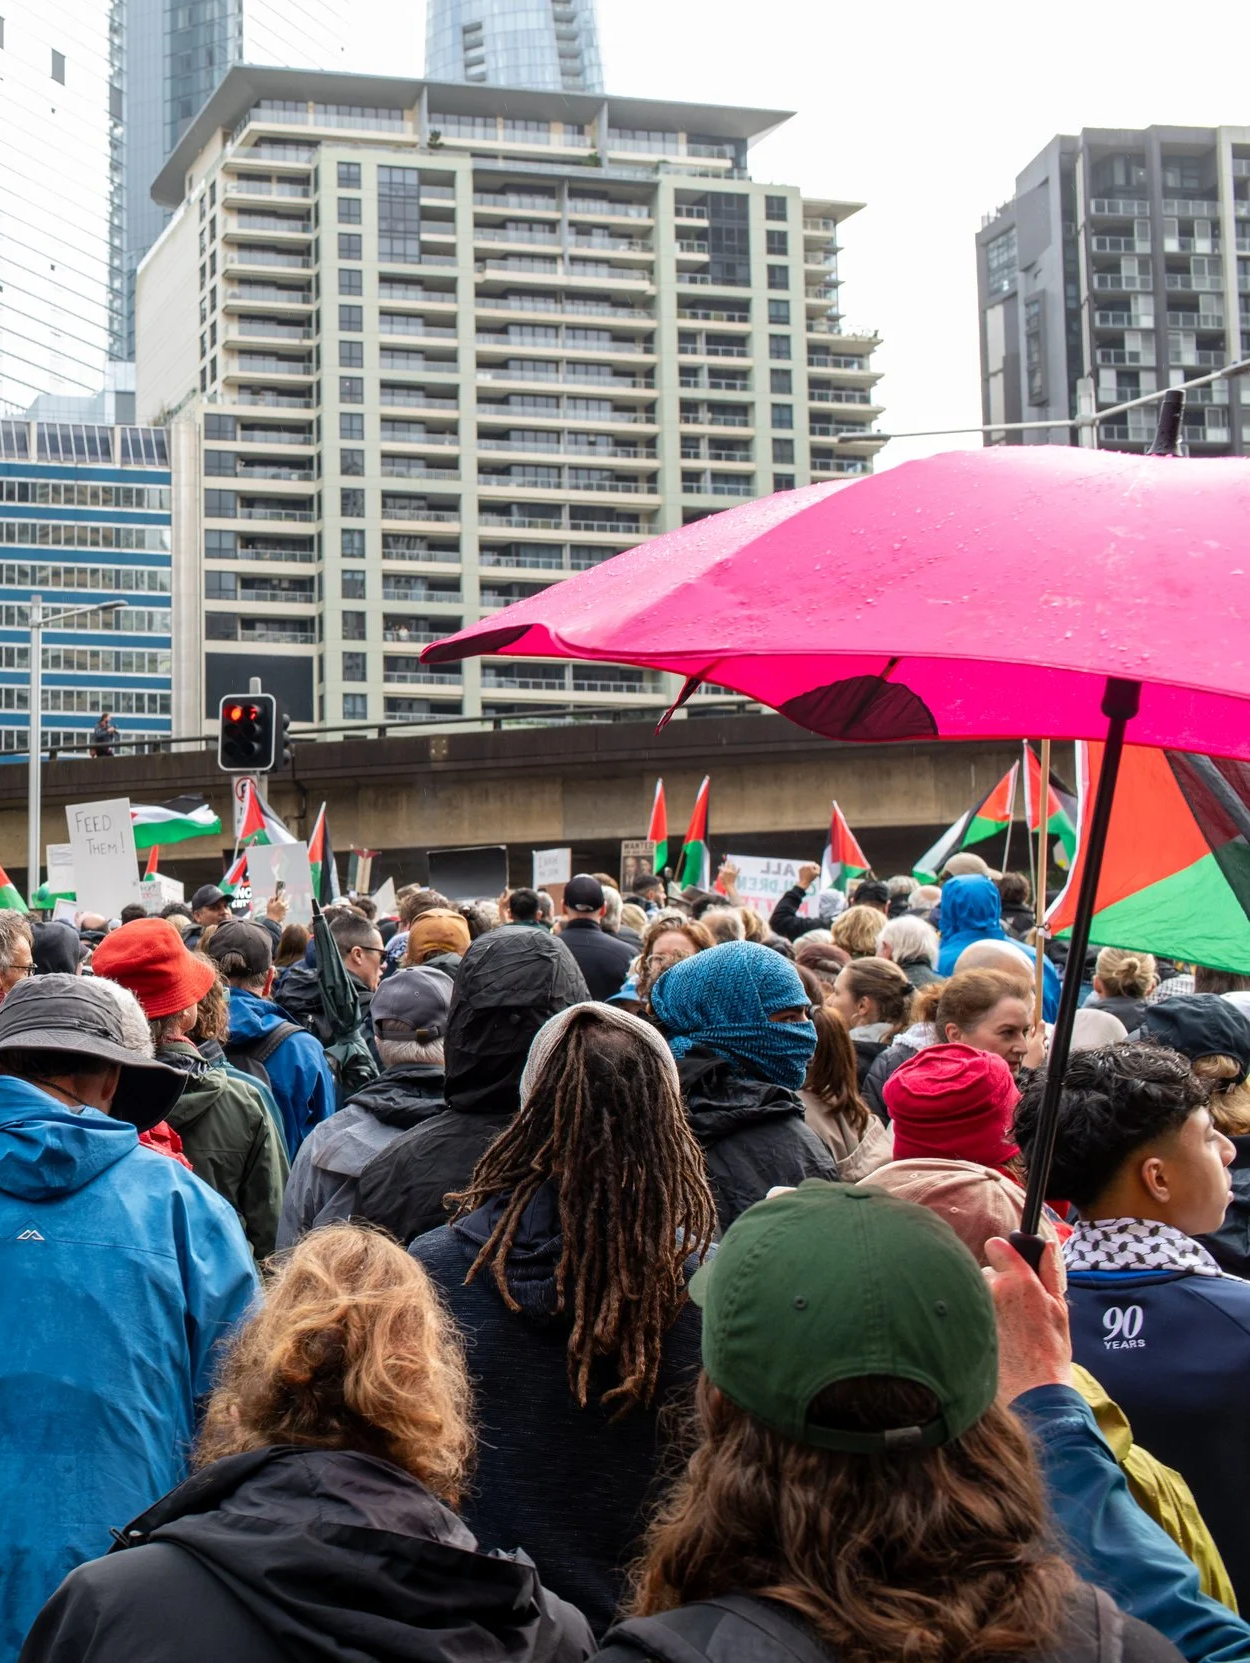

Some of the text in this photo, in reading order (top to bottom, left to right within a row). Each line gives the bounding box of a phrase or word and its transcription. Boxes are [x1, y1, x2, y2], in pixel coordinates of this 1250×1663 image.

[74, 811, 113, 833] FEED
[86, 831, 126, 855] THEM!
[1103, 1305, 1143, 1341] 90
[1103, 1339, 1145, 1350] YEARS
